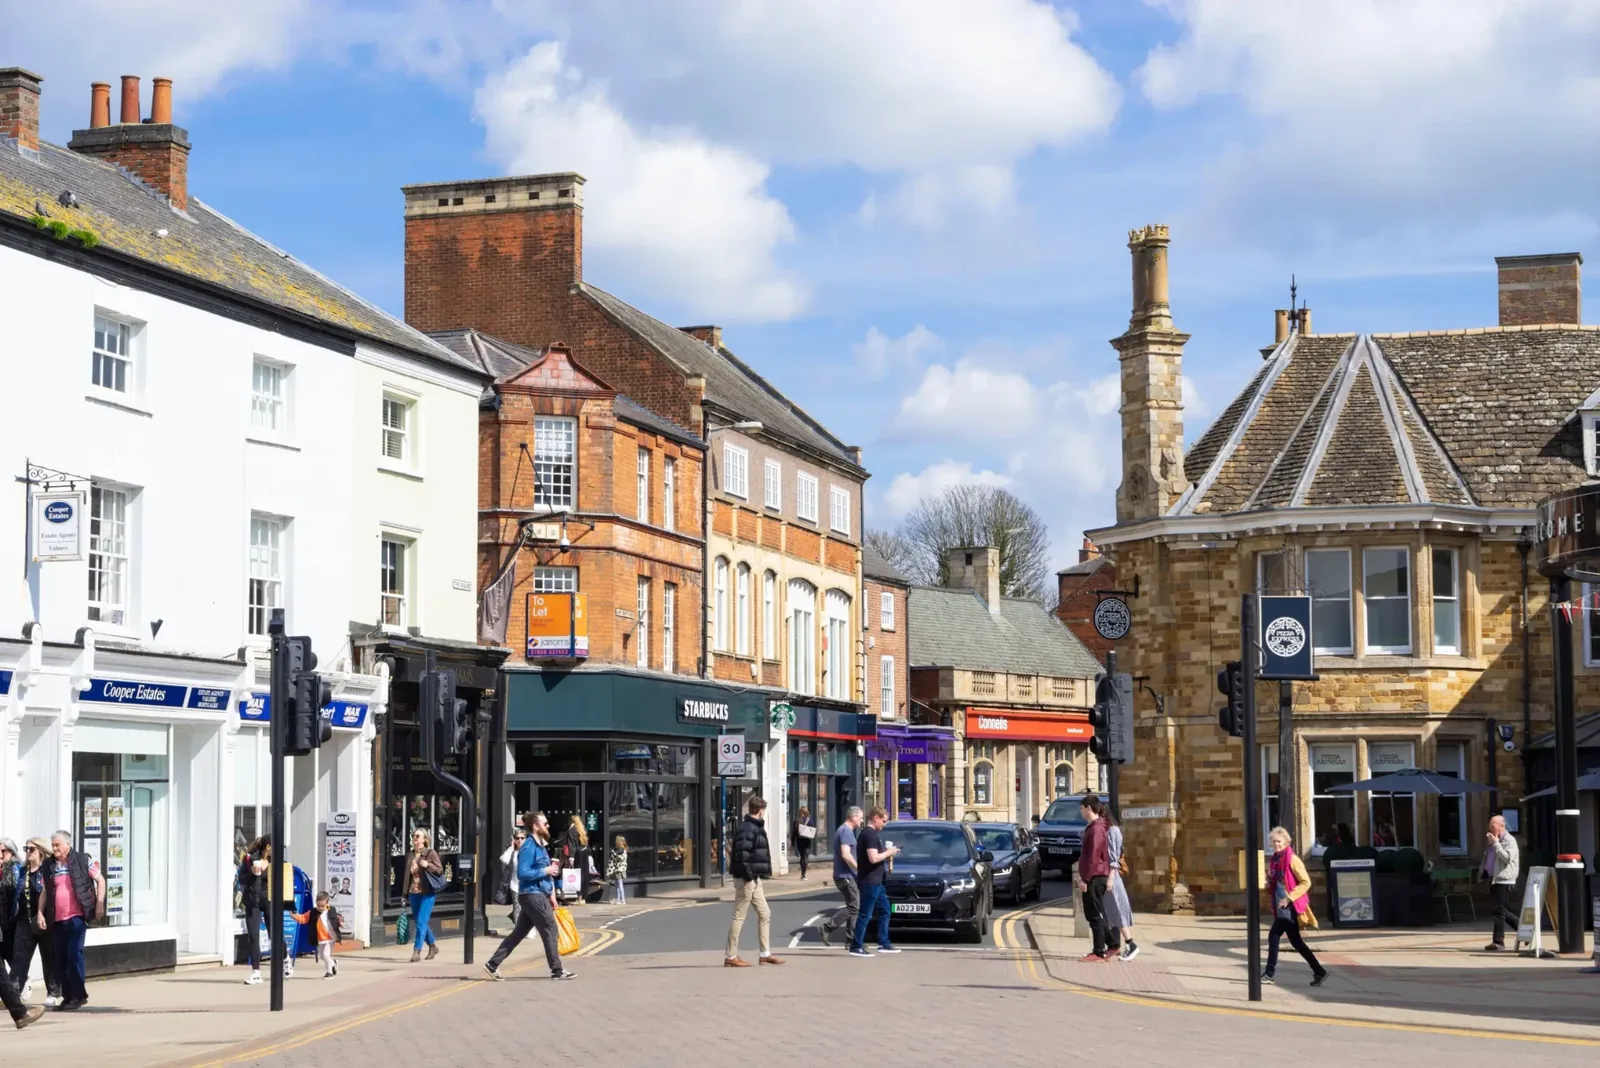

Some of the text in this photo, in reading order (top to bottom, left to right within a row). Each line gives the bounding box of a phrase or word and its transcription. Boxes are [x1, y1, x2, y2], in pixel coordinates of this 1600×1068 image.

[48, 506, 69, 514] Cooper
[532, 596, 545, 606] To
[532, 607, 548, 617] Let
[540, 638, 570, 647] jarroms
[103, 681, 166, 702] Cooper Estates
[246, 698, 265, 709] MAX
[344, 706, 362, 717] MAX
[684, 700, 728, 720] STARBUCKS
[978, 715, 1008, 730] Connells
[723, 743, 740, 754] 30
[916, 904, 930, 912] BNJ
